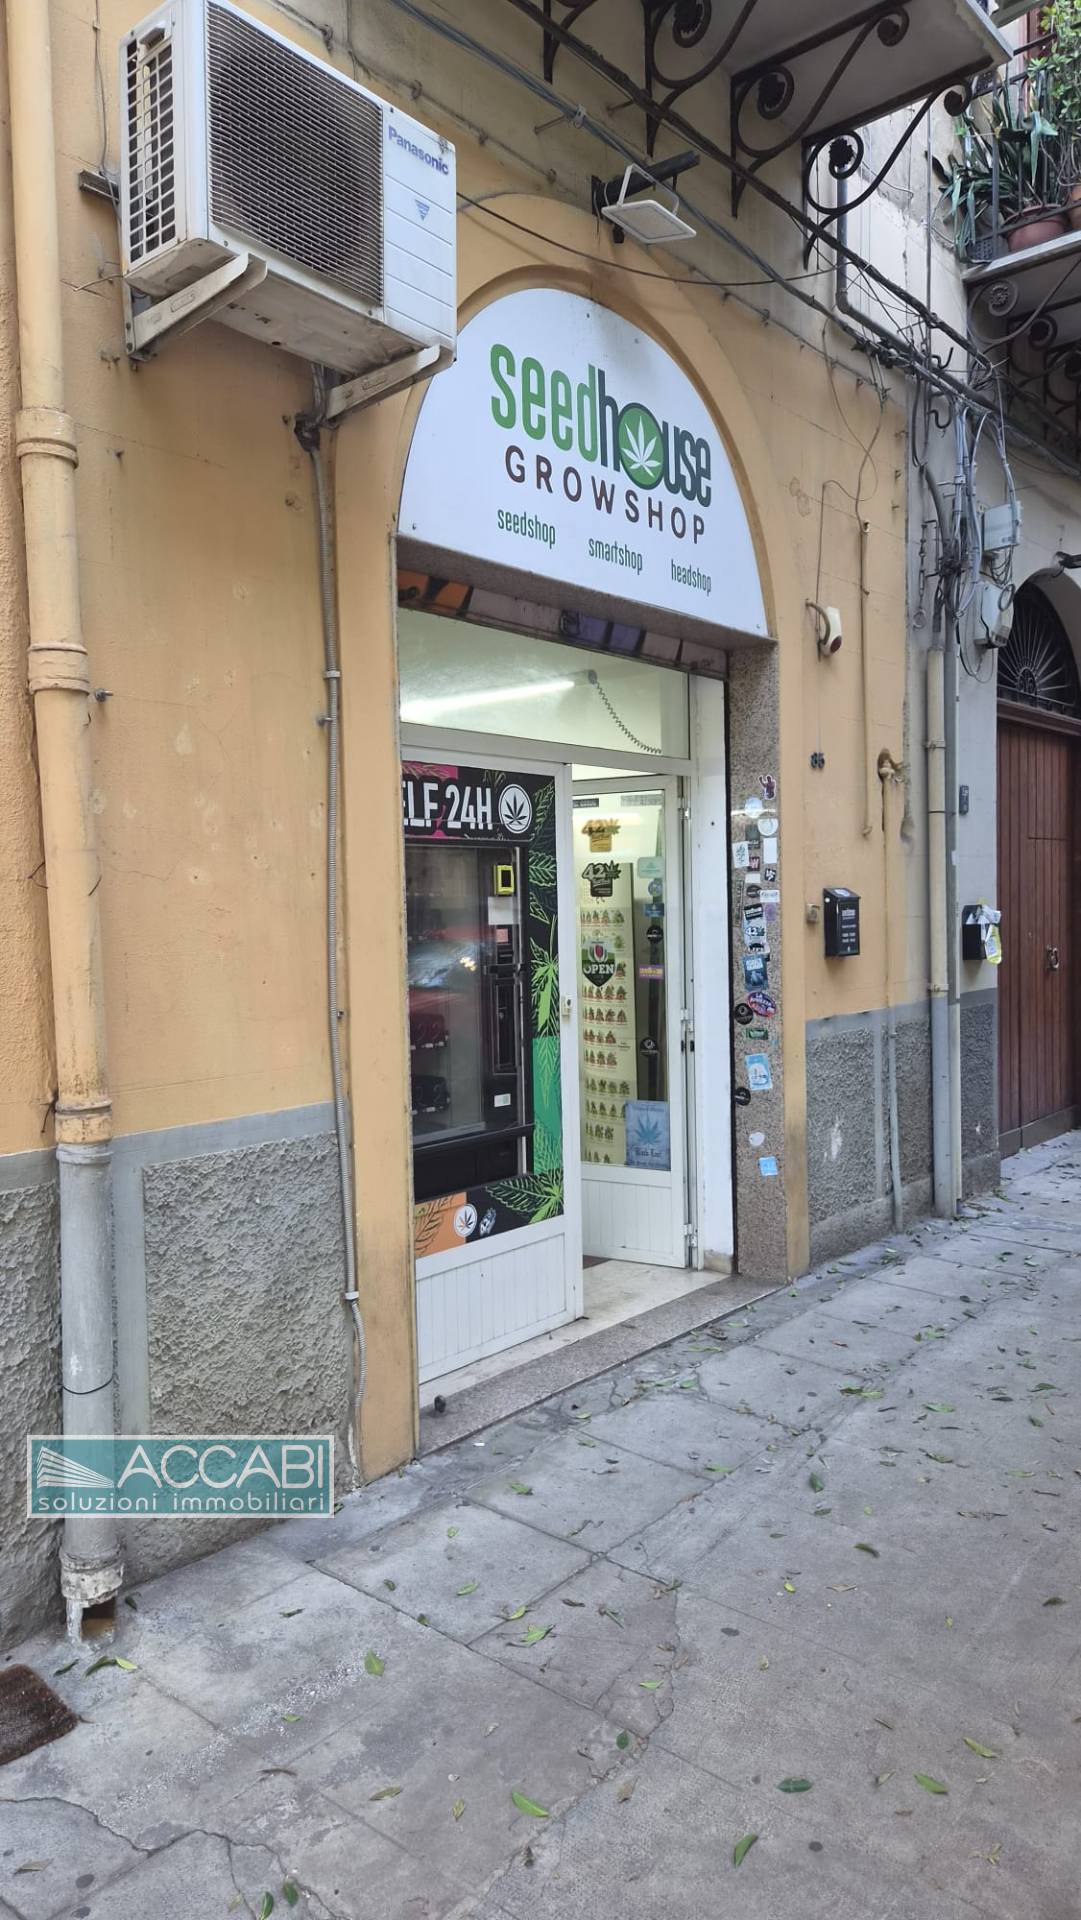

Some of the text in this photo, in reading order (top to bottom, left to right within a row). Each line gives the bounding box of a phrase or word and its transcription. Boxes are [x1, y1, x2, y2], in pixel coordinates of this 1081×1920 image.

[388, 126, 449, 175] Panasonic
[490, 344, 711, 507] seedhouse
[505, 445, 705, 544] GROWSHOP
[497, 509, 712, 597] seedshop smartshop headshop
[402, 781, 493, 830] LF 24H
[583, 964, 614, 975] OPEN
